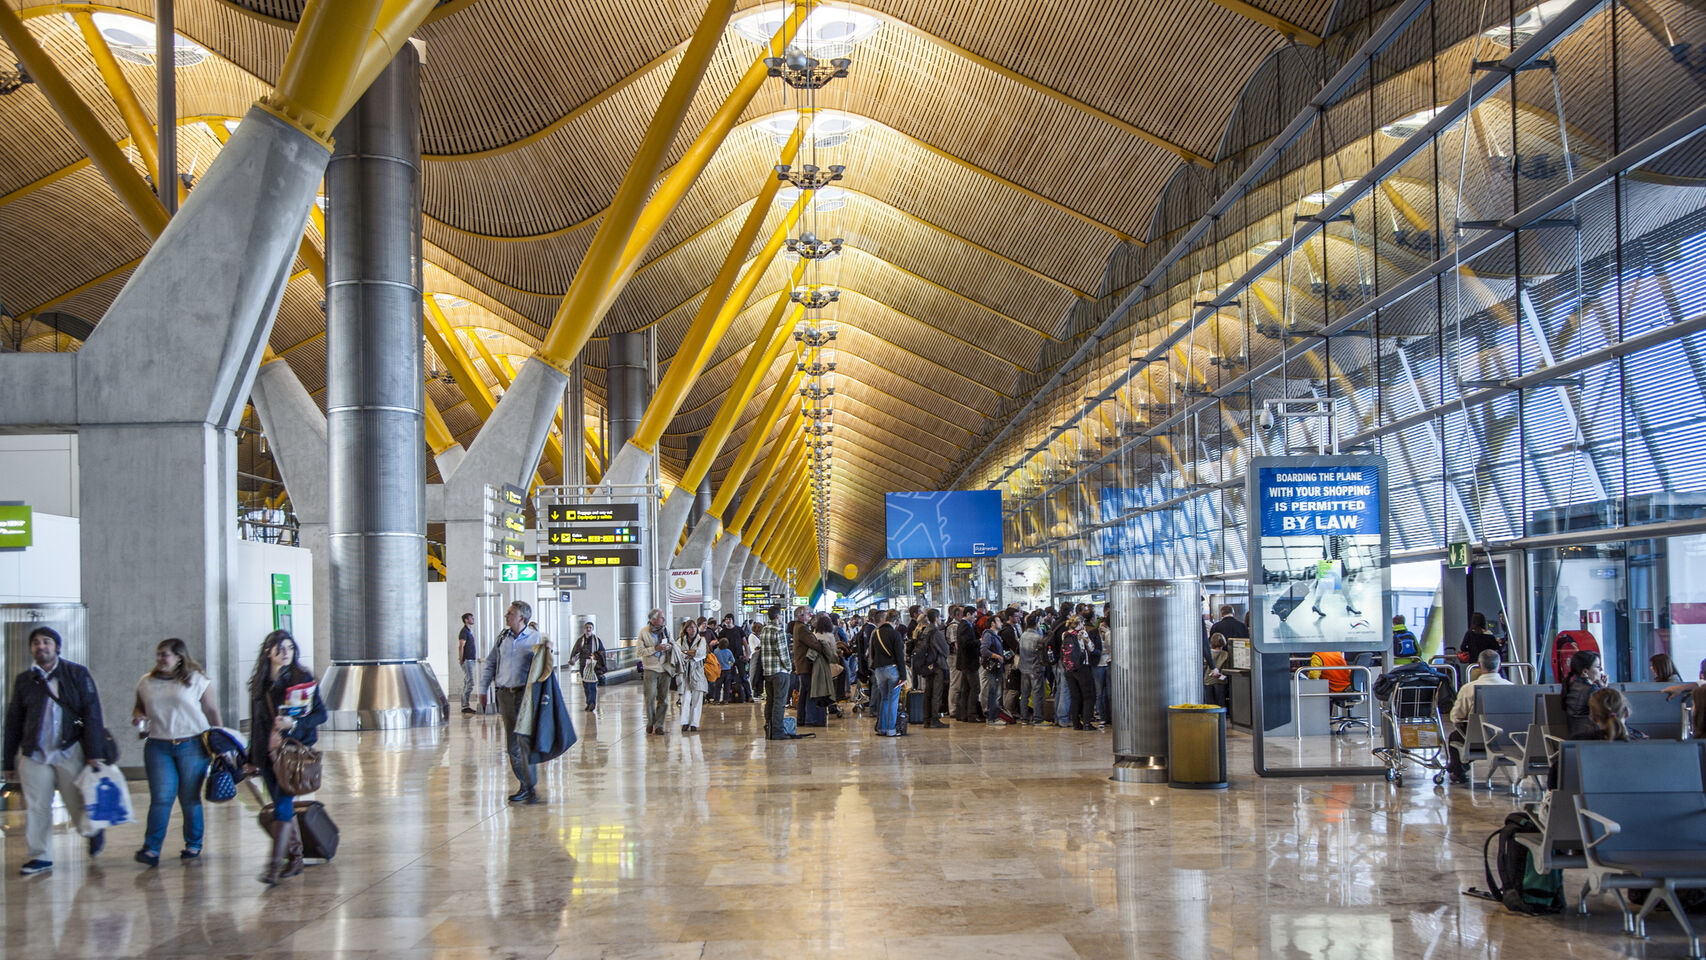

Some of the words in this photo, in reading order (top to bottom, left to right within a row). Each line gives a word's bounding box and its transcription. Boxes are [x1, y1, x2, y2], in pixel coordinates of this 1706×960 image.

[1276, 472, 1317, 482] BOARDING
[1318, 472, 1335, 482] THE
[1336, 472, 1362, 481] PLANE
[1269, 487, 1293, 497] WITH
[1295, 486, 1321, 497] YOUR
[1323, 485, 1371, 496] SHOPPING
[1275, 502, 1288, 512] IS
[1291, 501, 1366, 511] PERMITTED
[1283, 516, 1309, 530] BY
[1315, 515, 1358, 530] LAW
